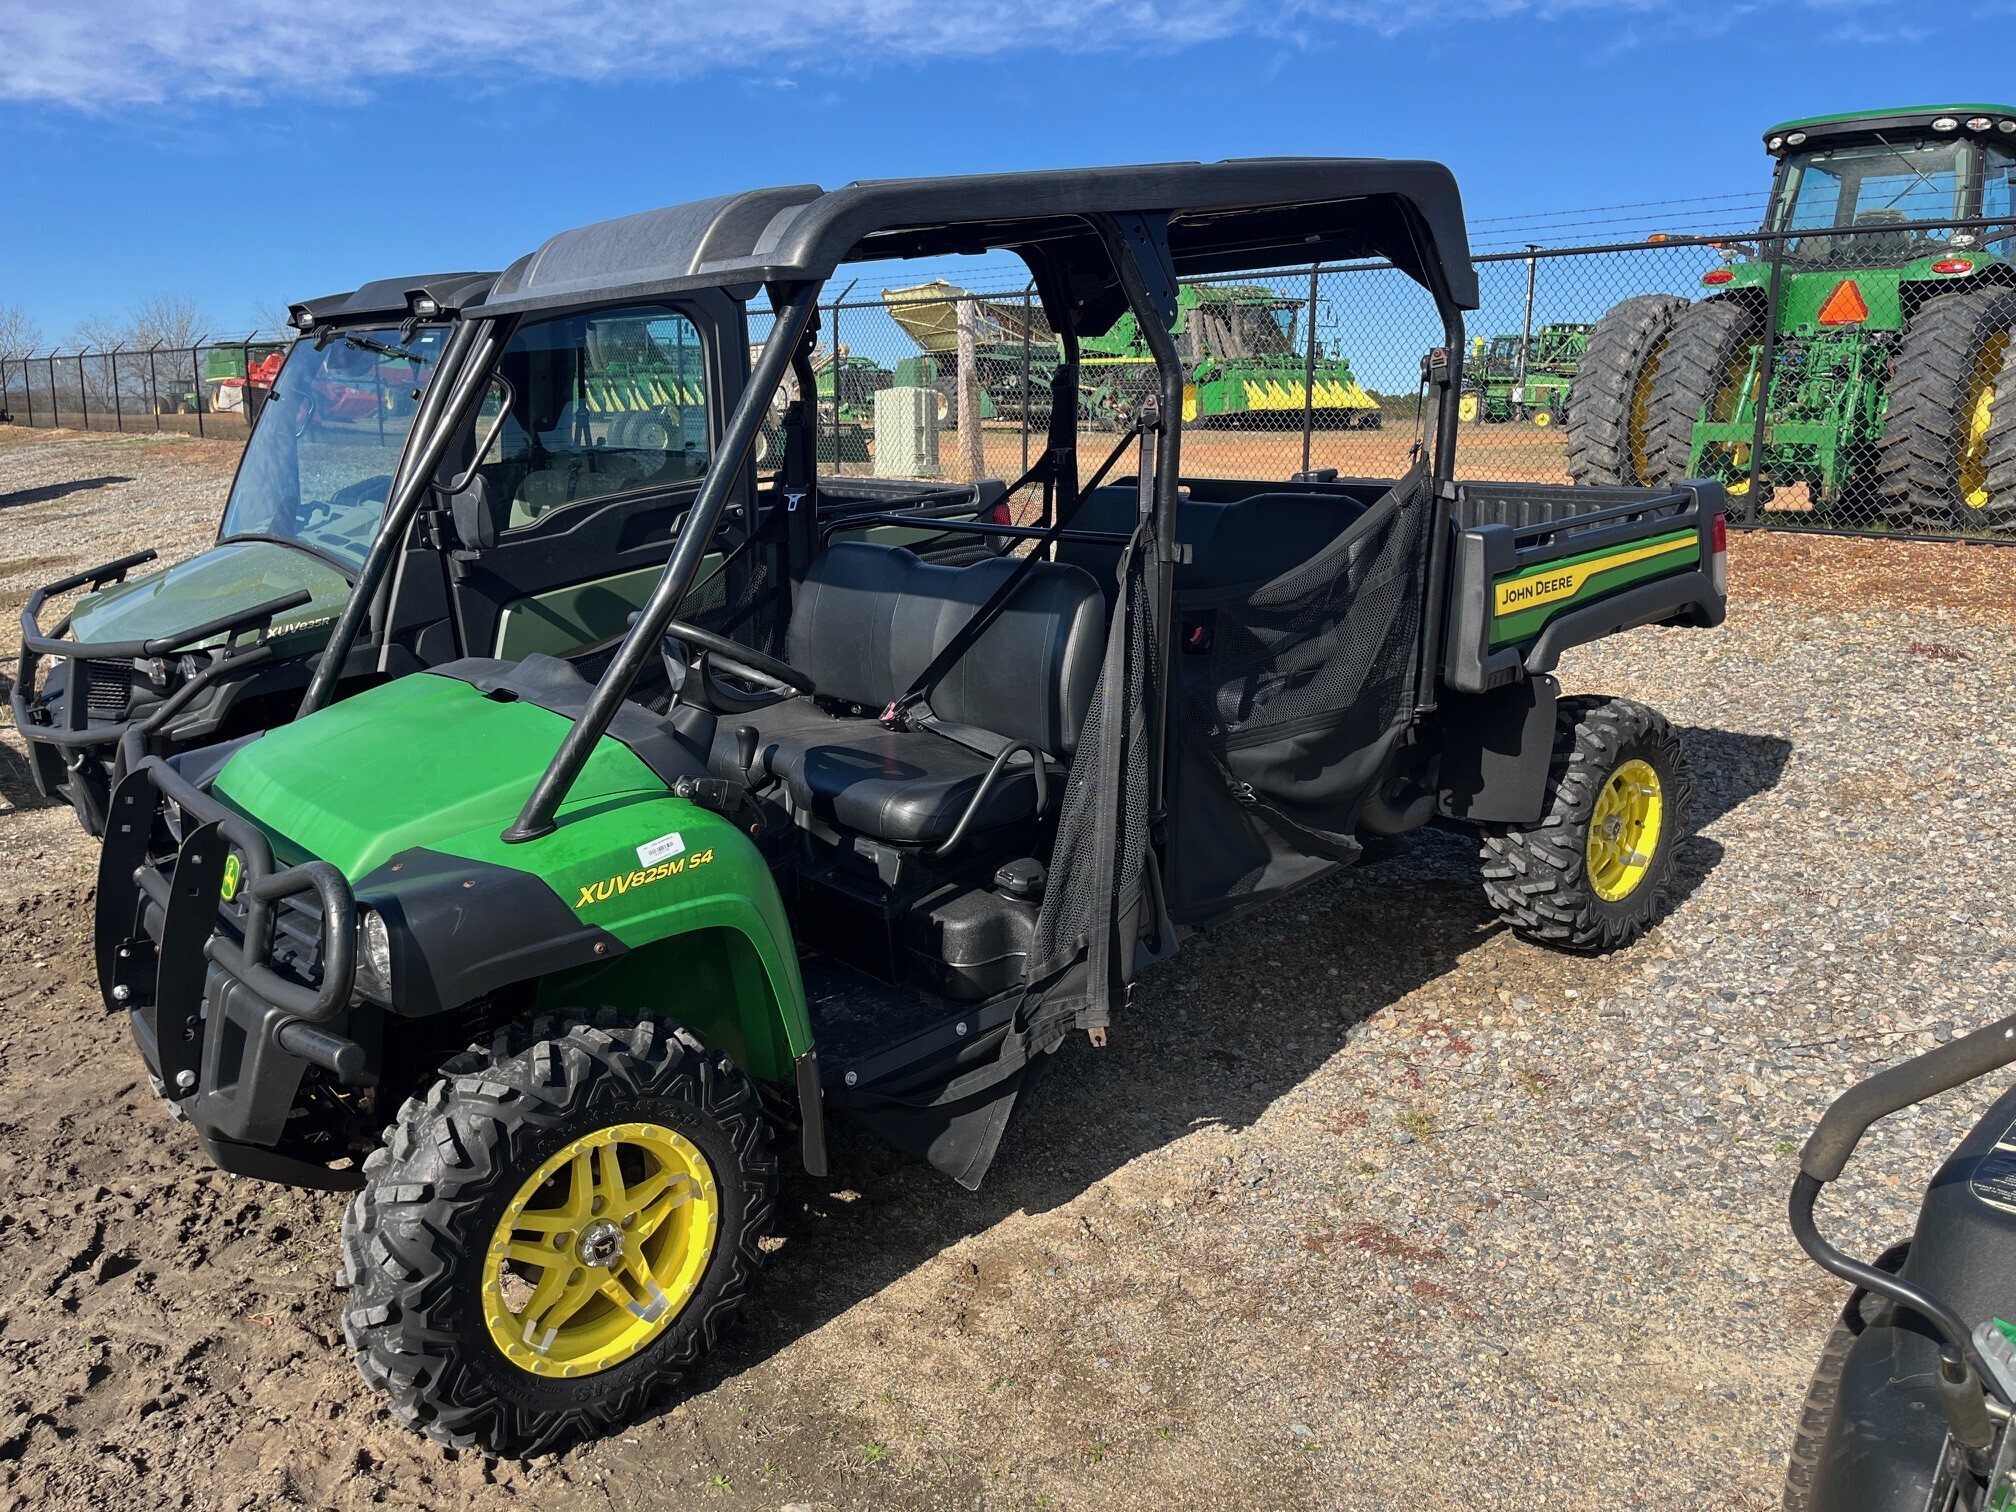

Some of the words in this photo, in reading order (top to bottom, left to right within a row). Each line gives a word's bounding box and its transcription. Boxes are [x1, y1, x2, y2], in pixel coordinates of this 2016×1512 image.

[1502, 585, 1533, 605] JOHN
[1536, 575, 1573, 595] DEERE
[573, 858, 685, 910] XUV825M
[689, 849, 714, 870] S4
